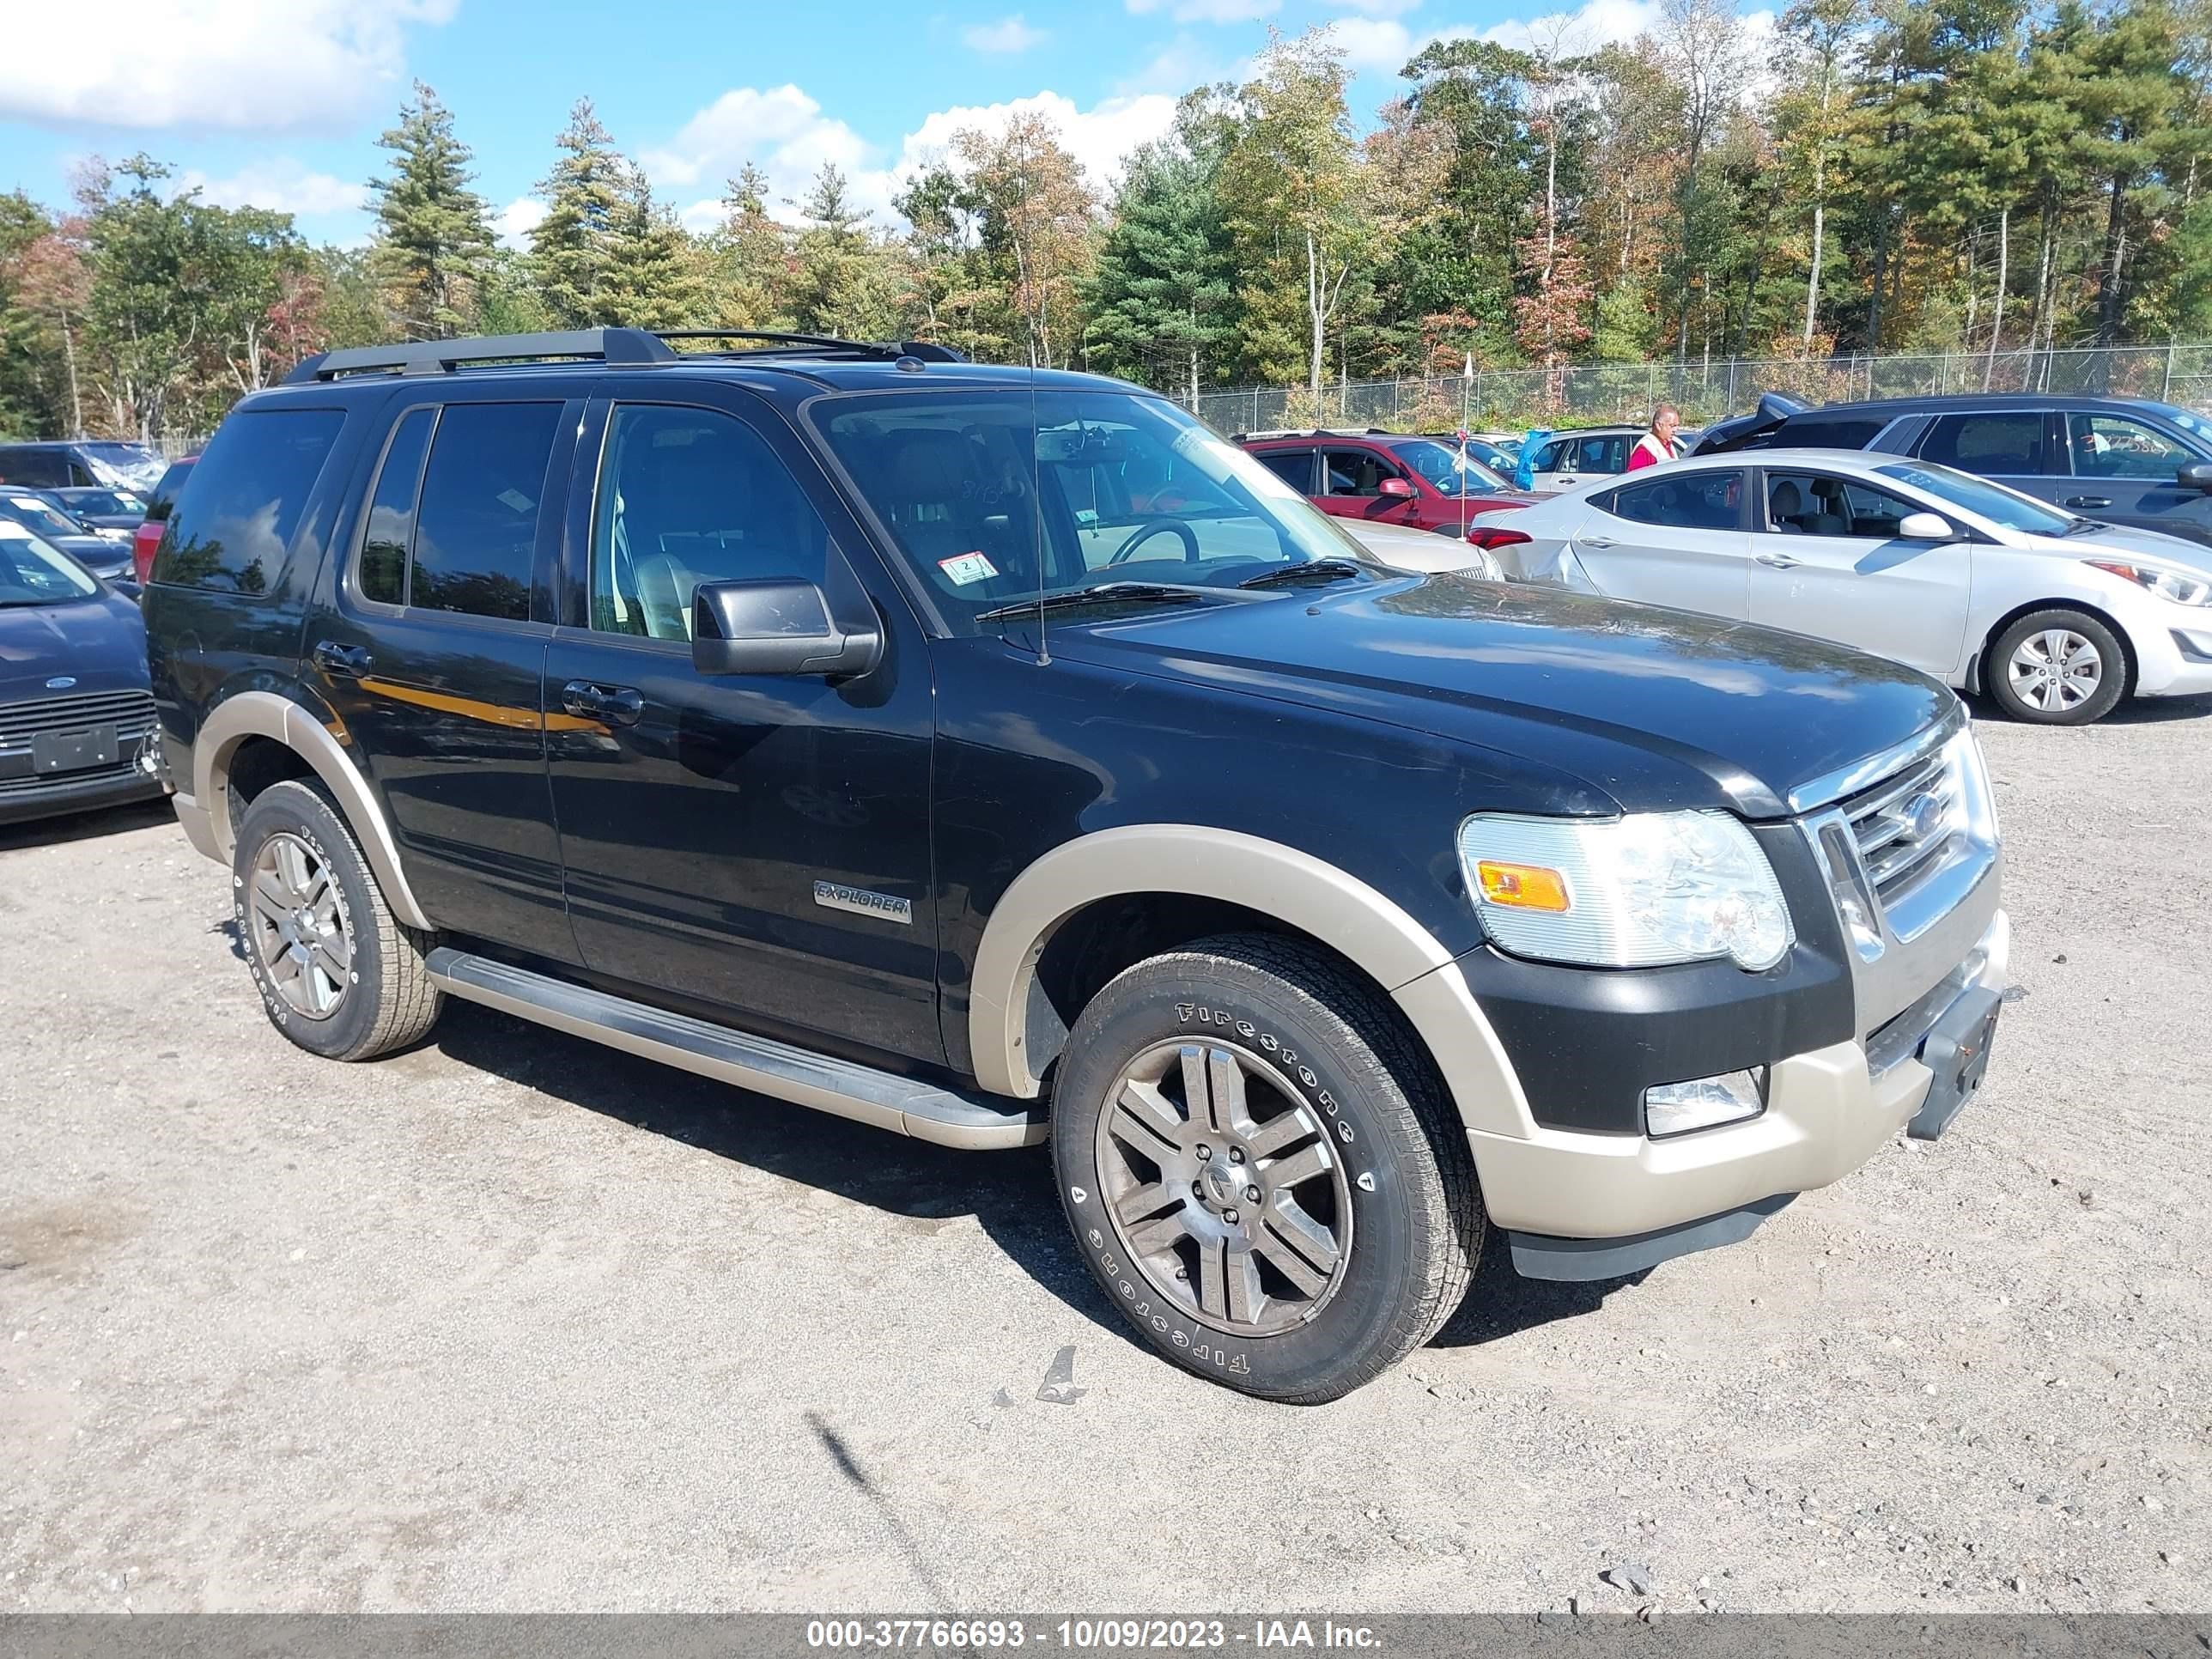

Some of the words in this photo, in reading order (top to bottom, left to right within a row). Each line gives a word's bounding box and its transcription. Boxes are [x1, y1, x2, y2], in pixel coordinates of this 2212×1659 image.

[816, 884, 908, 915] EXPLORER
[1174, 1002, 1354, 1145] Firestone
[1087, 1227, 1250, 1375] Firestone
